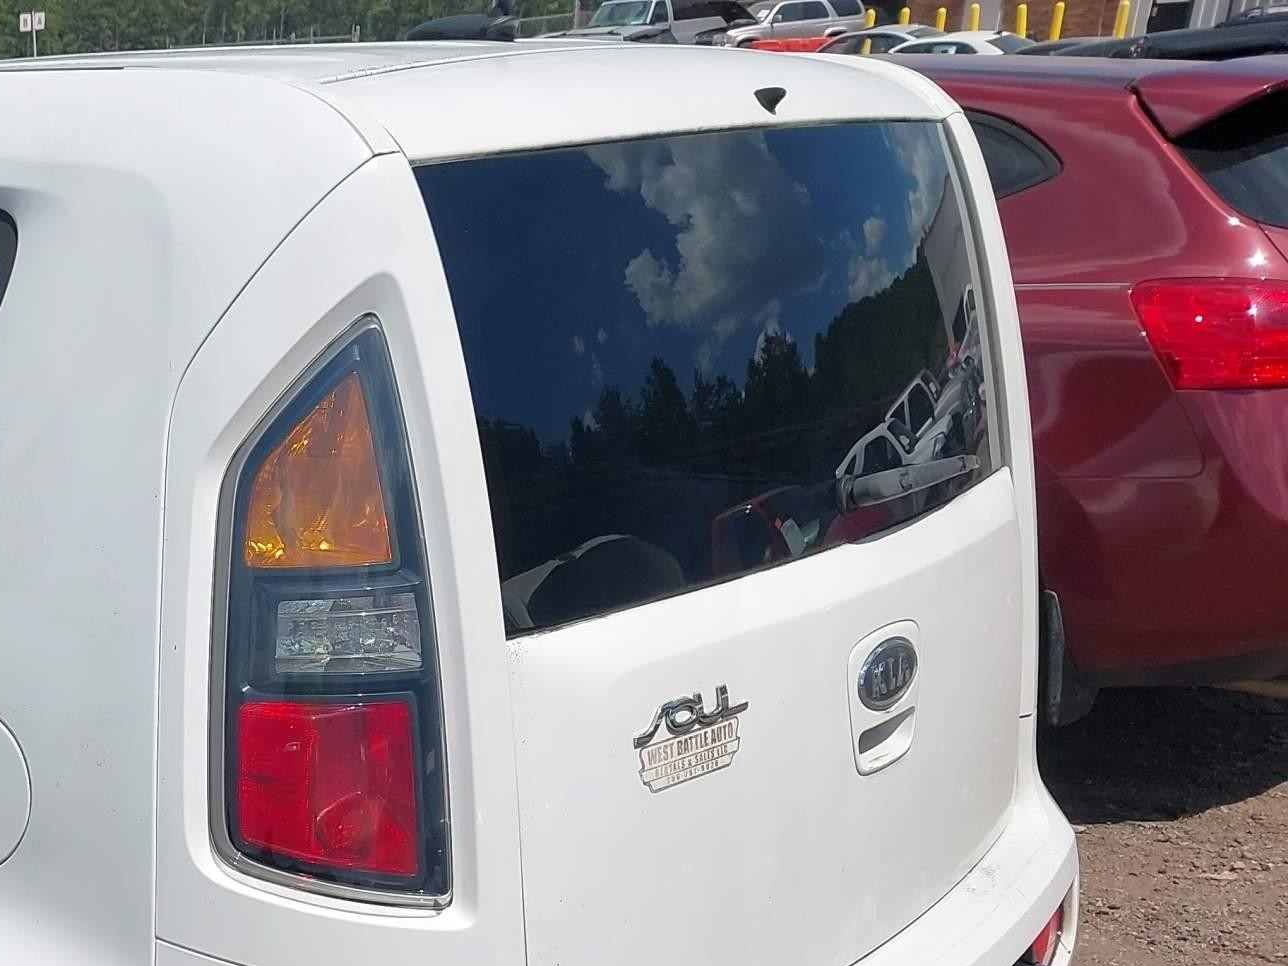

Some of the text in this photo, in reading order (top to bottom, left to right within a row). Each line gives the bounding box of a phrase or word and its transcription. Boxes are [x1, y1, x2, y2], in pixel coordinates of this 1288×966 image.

[872, 653, 911, 698] KIA
[647, 722, 734, 766] WEST BATTLE AUTO
[694, 750, 715, 764] SALES
